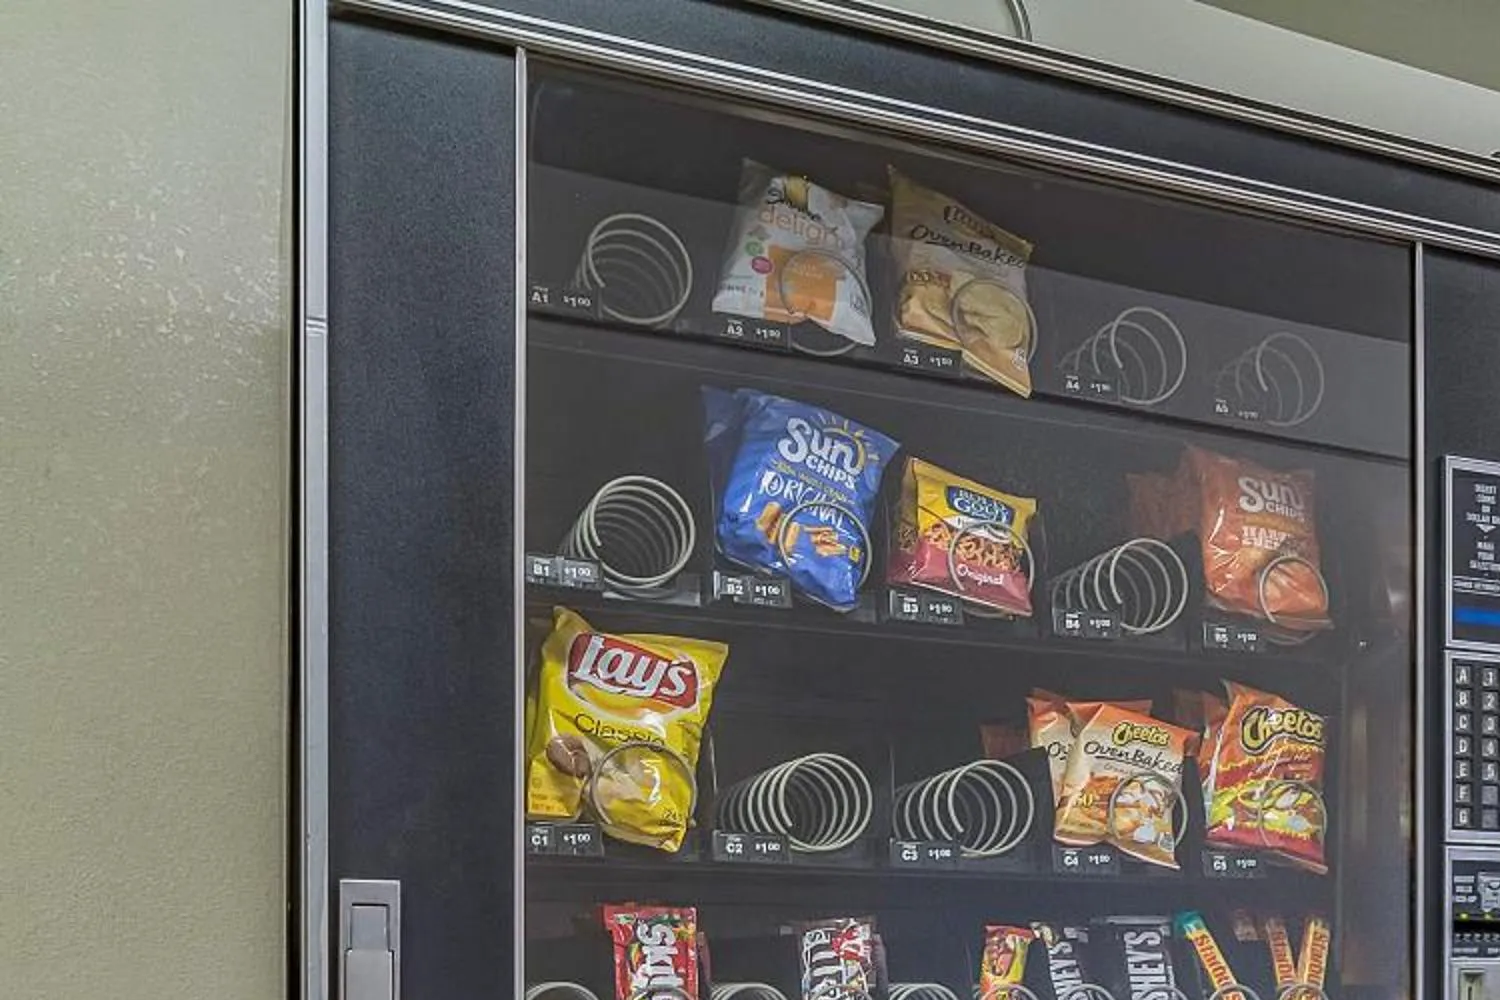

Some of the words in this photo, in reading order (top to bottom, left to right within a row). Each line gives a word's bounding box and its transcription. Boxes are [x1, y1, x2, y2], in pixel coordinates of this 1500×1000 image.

[531, 291, 549, 304] A1
[777, 417, 865, 475] Sun
[805, 455, 856, 490] CHIPS
[1238, 476, 1305, 513] Sun
[533, 564, 550, 577] B1
[727, 583, 743, 595] B2
[903, 602, 918, 614] B3
[573, 635, 692, 697] Lay's
[575, 713, 665, 745] Classic
[1112, 722, 1170, 746] Cheetos
[1241, 706, 1324, 753] Cheetos
[1083, 740, 1130, 759] Oven
[531, 833, 549, 845] C1
[725, 842, 743, 853] C2
[901, 849, 918, 862] C3
